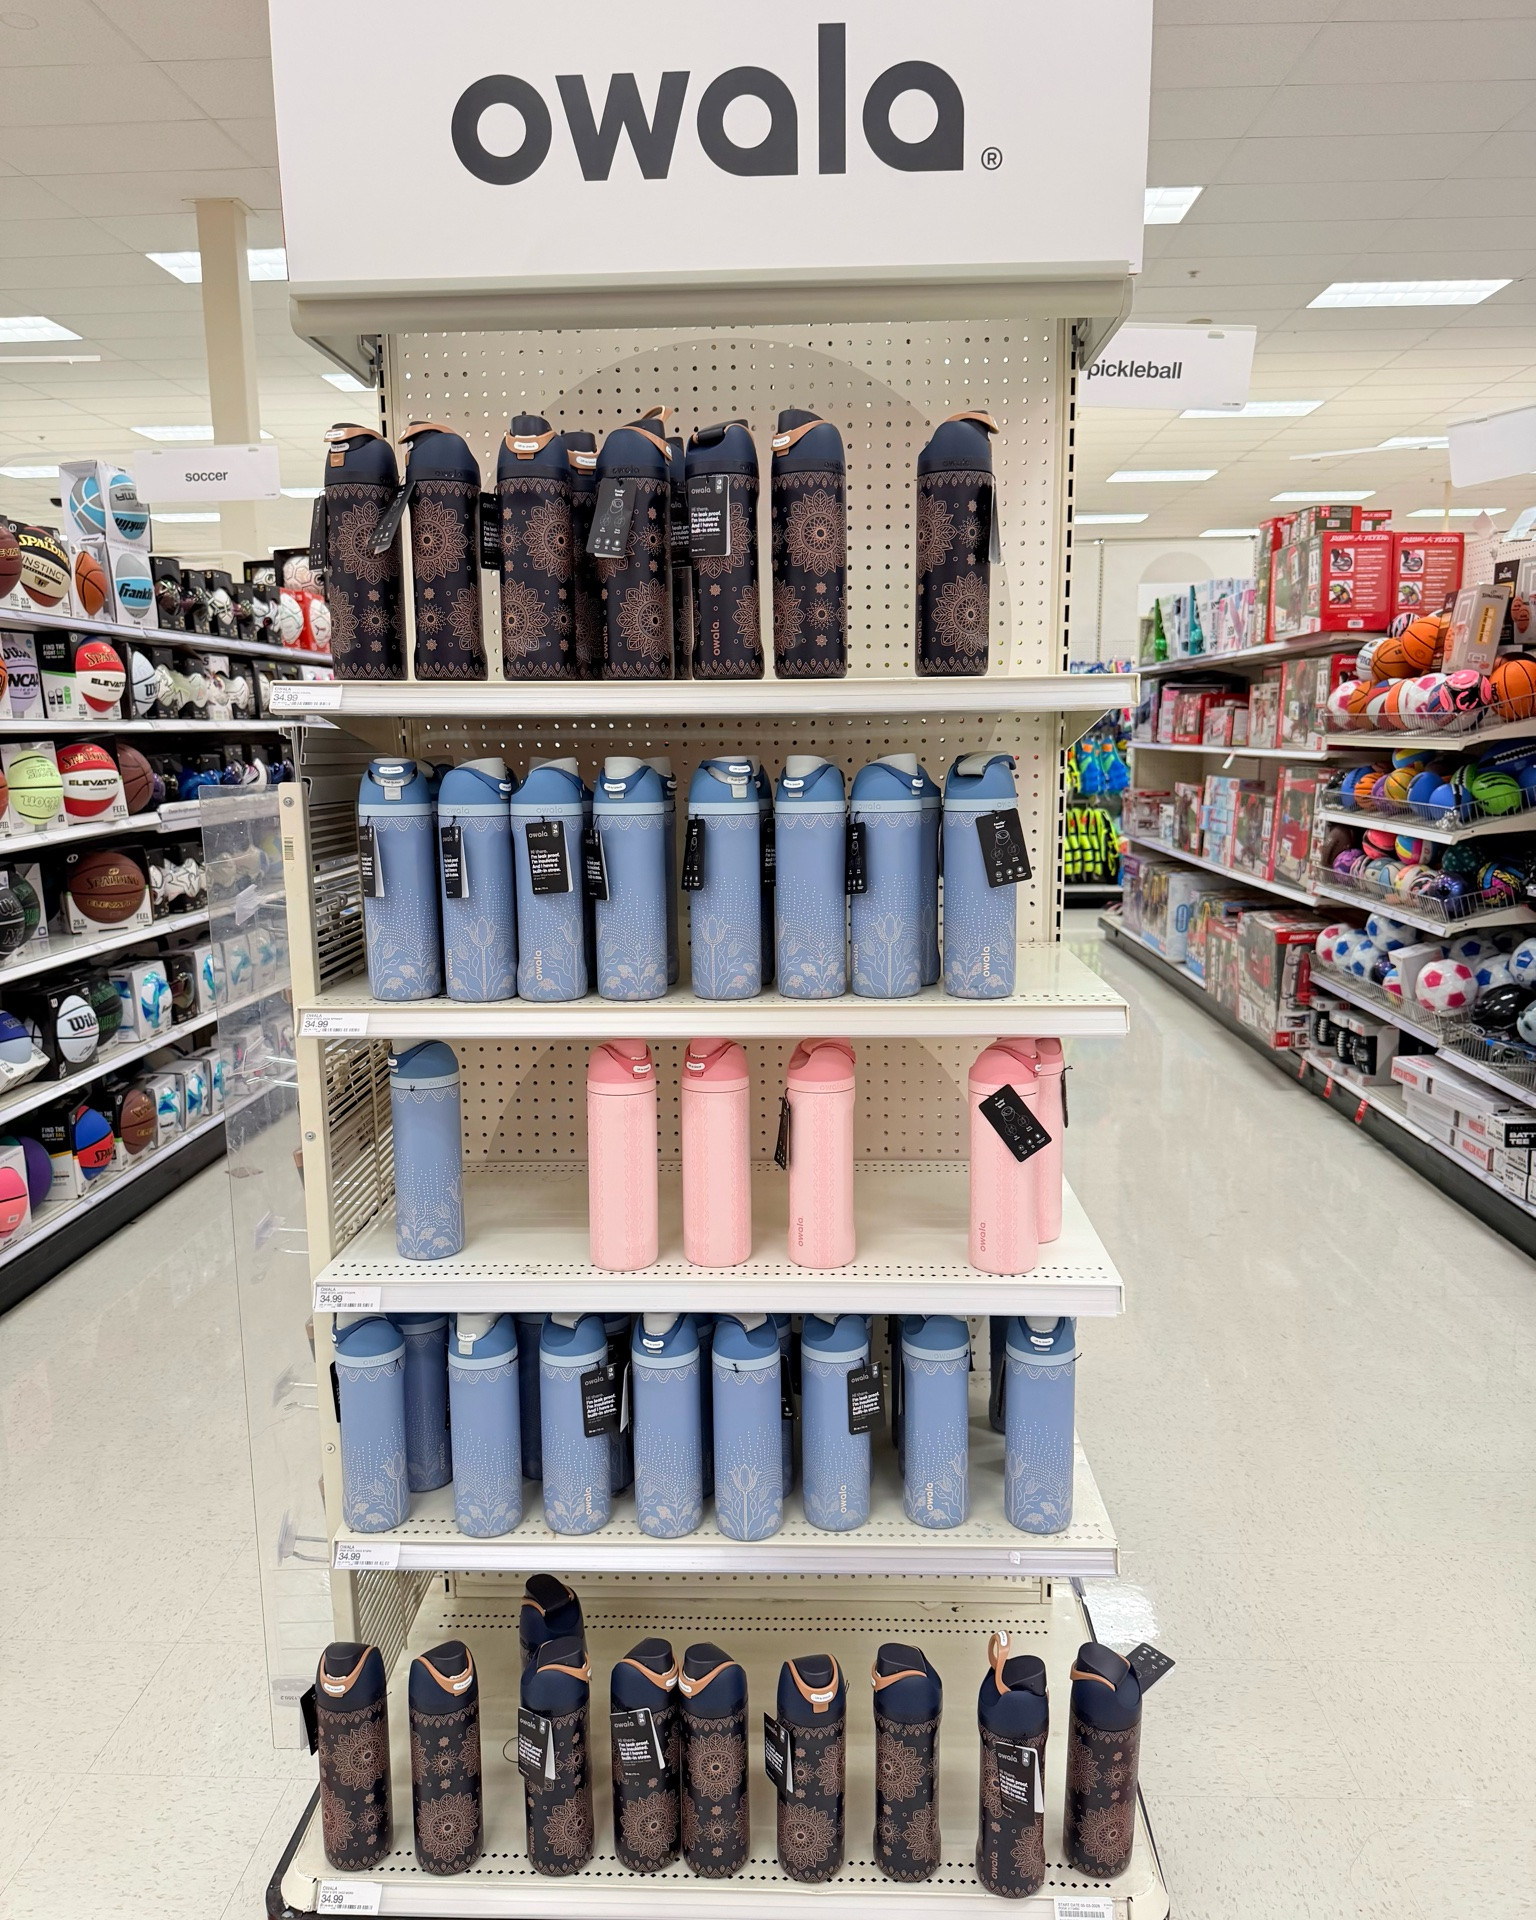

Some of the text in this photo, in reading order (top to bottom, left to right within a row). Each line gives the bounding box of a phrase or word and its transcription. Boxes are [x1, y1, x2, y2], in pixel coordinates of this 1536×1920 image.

[451, 23, 964, 186] owala
[1087, 359, 1182, 380] pickleball
[185, 471, 228, 482] soccer
[273, 694, 298, 702] 34.99
[535, 950, 543, 981] owala
[305, 1020, 329, 1028] 34.99
[320, 1294, 343, 1303] 34.99
[338, 1552, 361, 1560] 34.99
[321, 1894, 344, 1904] 34.99
